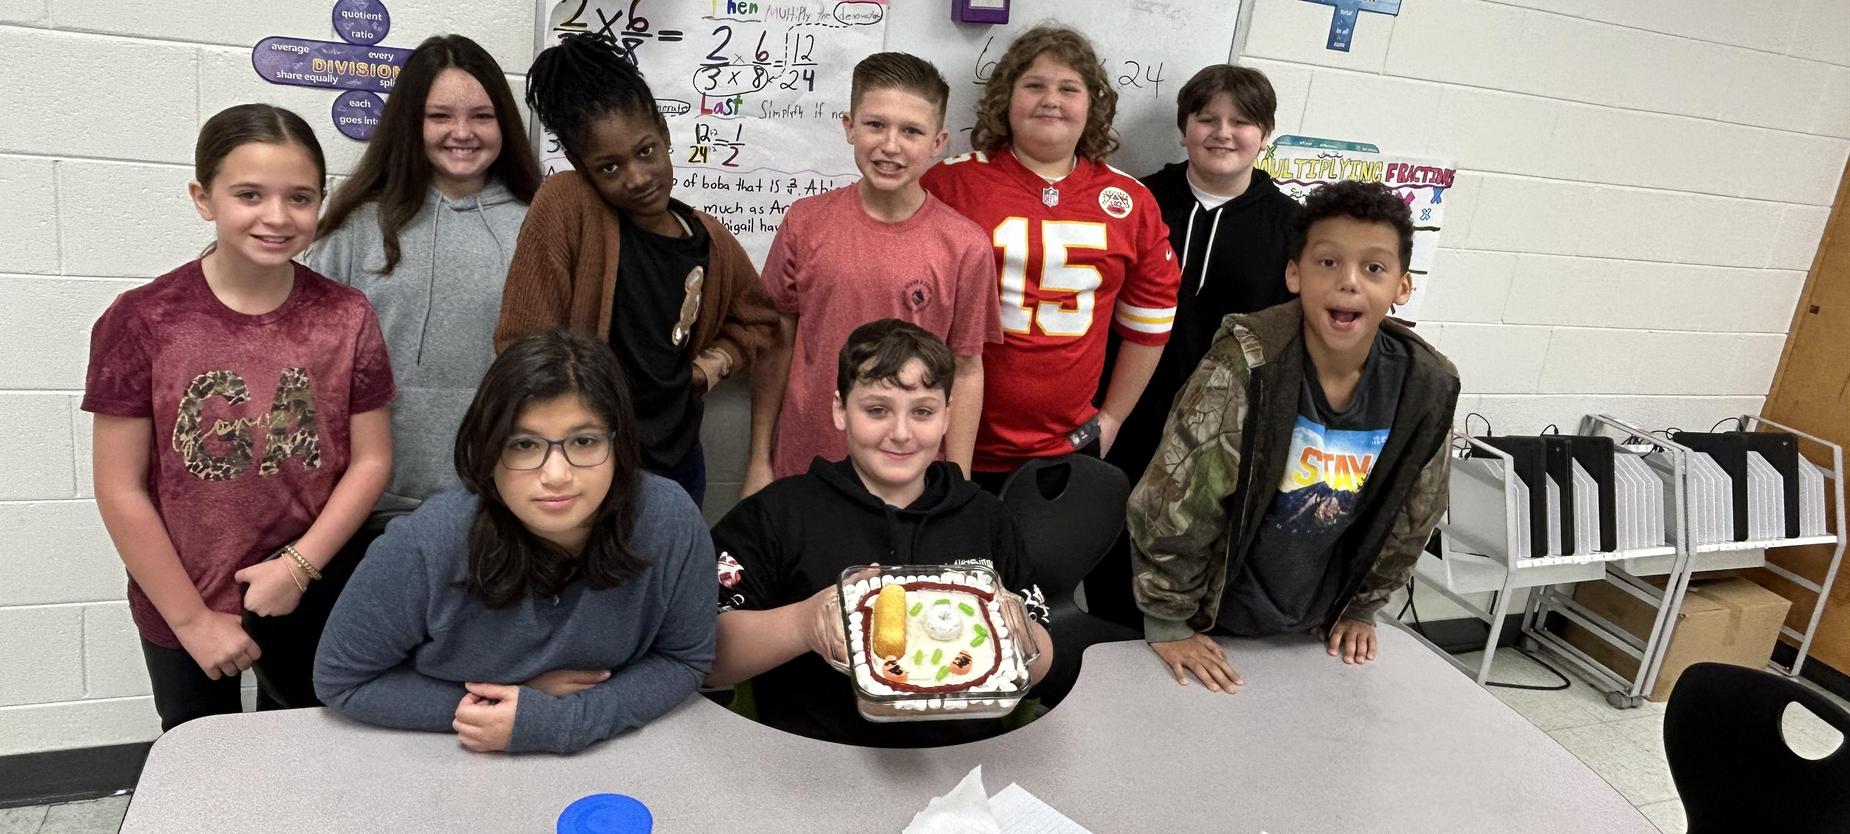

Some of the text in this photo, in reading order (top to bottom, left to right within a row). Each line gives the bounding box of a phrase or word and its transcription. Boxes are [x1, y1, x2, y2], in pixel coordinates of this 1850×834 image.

[341, 10, 383, 21] quotient
[625, 0, 649, 32] 6
[351, 30, 374, 39] ratio
[706, 25, 732, 61] 2
[755, 30, 769, 63] 6
[793, 33, 815, 64] 12
[271, 43, 310, 54] average
[368, 52, 394, 62] every
[276, 70, 338, 85] share equally
[701, 65, 721, 91] 3
[752, 65, 765, 88] 8
[780, 68, 815, 92] 24
[1118, 60, 1165, 99] 24
[349, 99, 371, 108] each
[700, 92, 743, 116] Last
[339, 116, 362, 126] goes
[695, 123, 711, 145] 12
[688, 146, 708, 163] 24
[722, 147, 739, 168] 2
[683, 173, 698, 188] of
[702, 176, 730, 190] boba
[736, 178, 762, 193] that
[1385, 162, 1456, 187] FRACTIONS
[703, 202, 743, 215] much
[749, 205, 765, 215] as
[720, 216, 781, 235] bigail hav
[993, 216, 1108, 337] 15
[178, 367, 322, 481] GA
[1292, 445, 1374, 494] STAY
